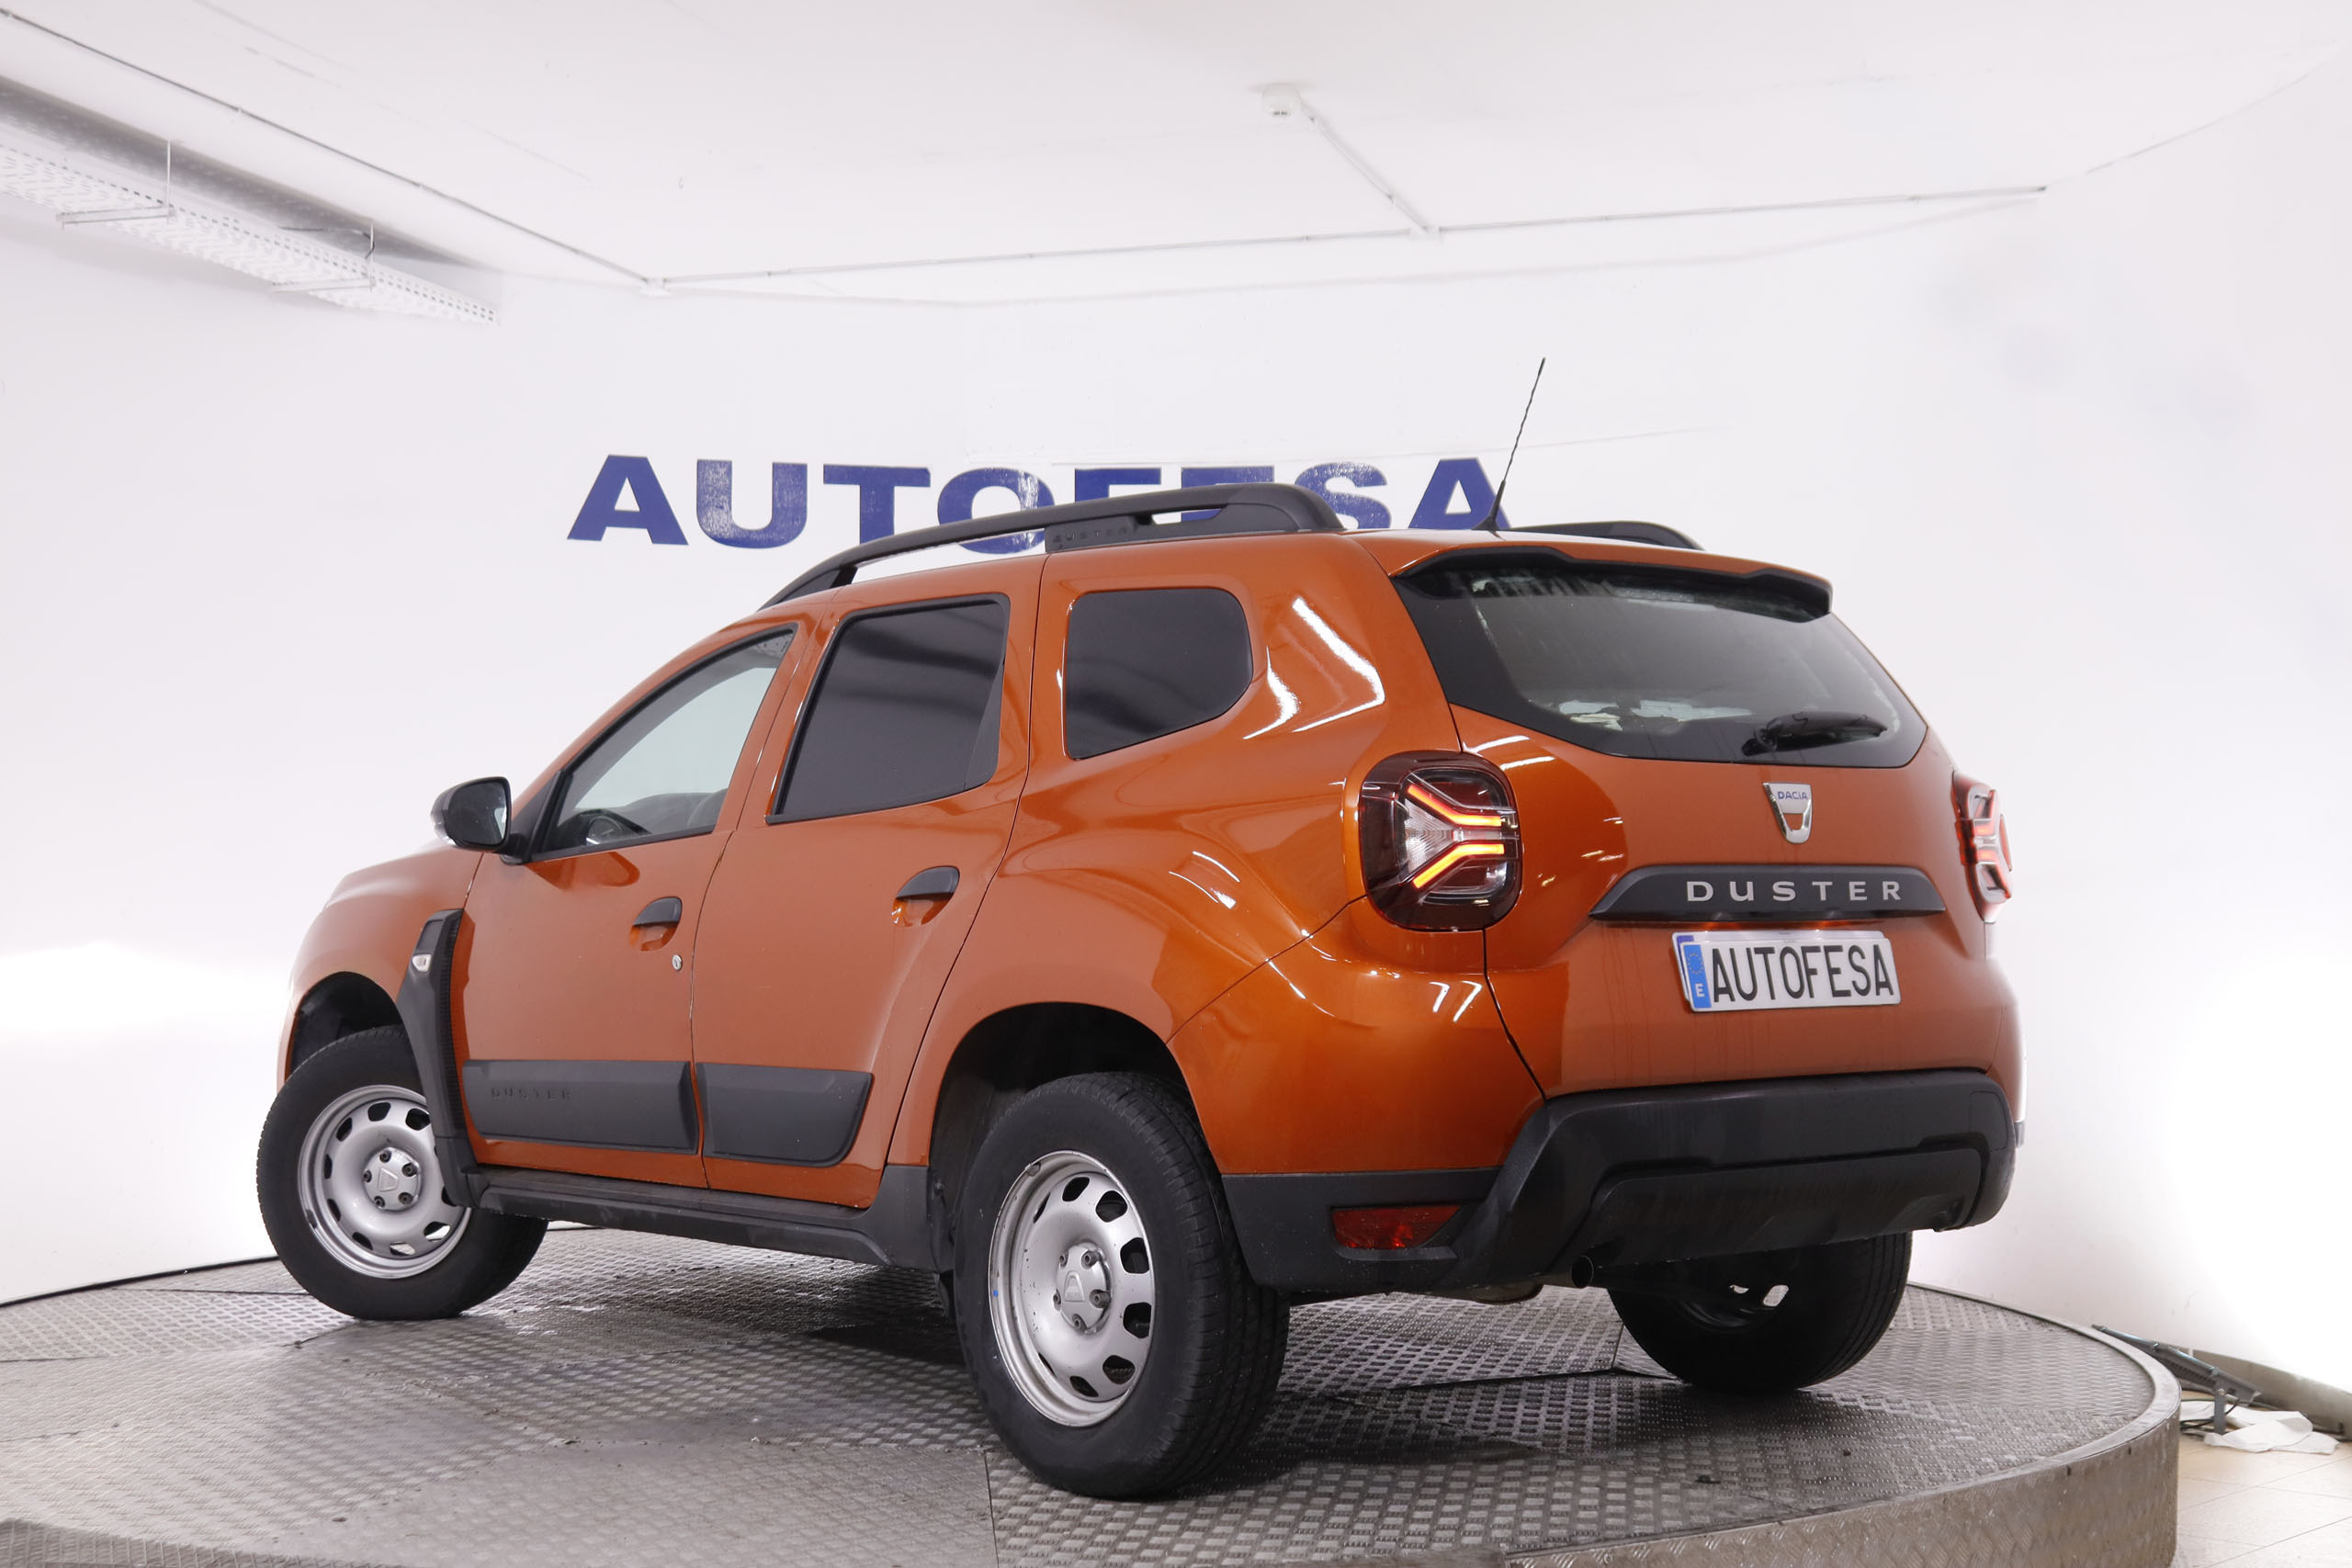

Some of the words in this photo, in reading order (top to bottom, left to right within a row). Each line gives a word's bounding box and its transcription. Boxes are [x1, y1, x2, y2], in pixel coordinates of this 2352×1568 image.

[1778, 791, 1808, 800] DACIA
[1687, 880, 1902, 902] DUSTER
[1712, 944, 1894, 1002] AUTOFESA
[1695, 983, 1705, 998] E
